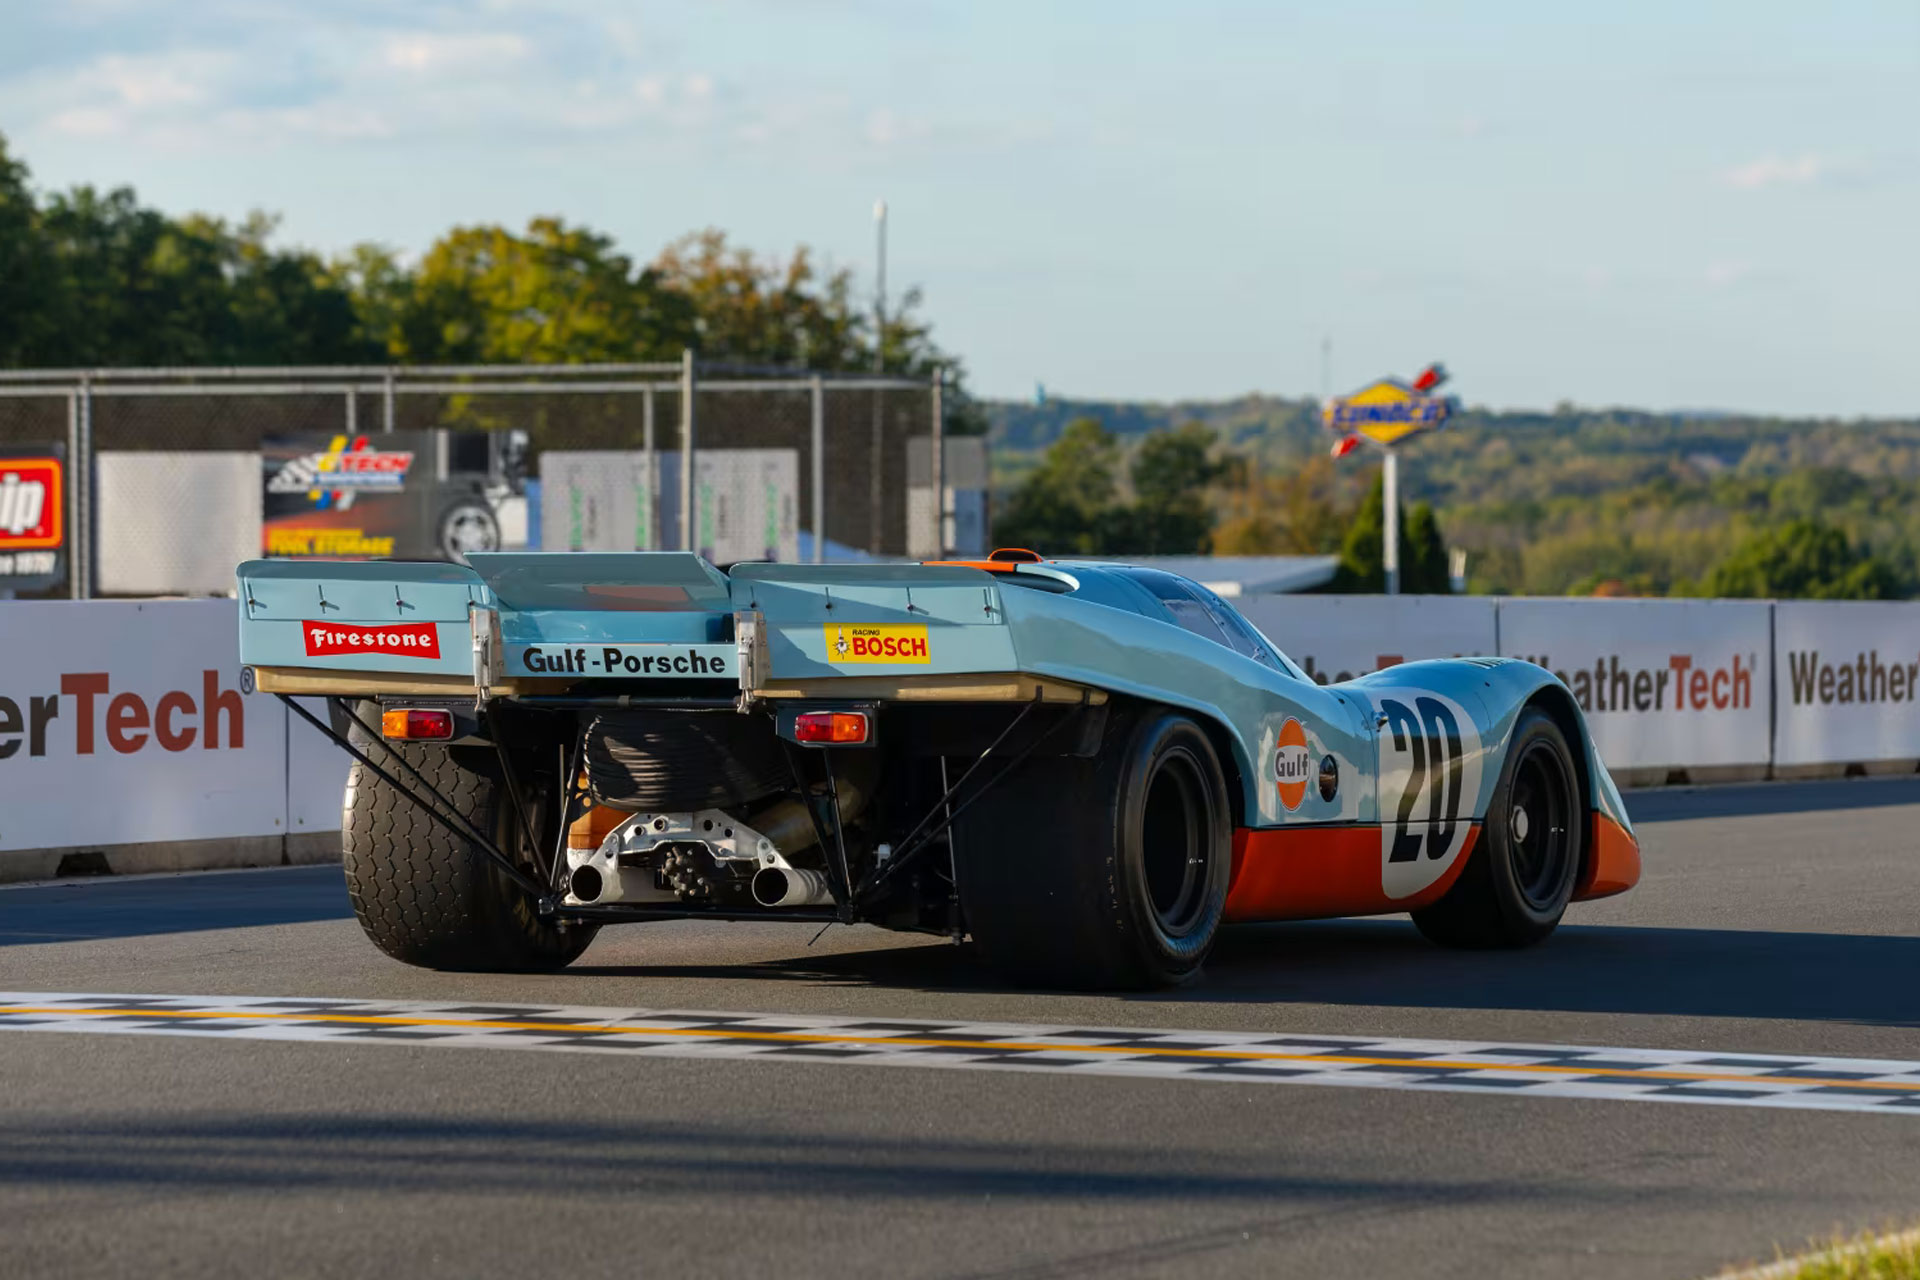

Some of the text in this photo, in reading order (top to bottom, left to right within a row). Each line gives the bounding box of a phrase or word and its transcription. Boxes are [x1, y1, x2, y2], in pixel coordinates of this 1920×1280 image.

[310, 628, 432, 648] Firestone
[852, 637, 926, 657] BOSCH
[1275, 751, 1309, 777] Gulf
[1380, 697, 1464, 863] 20
